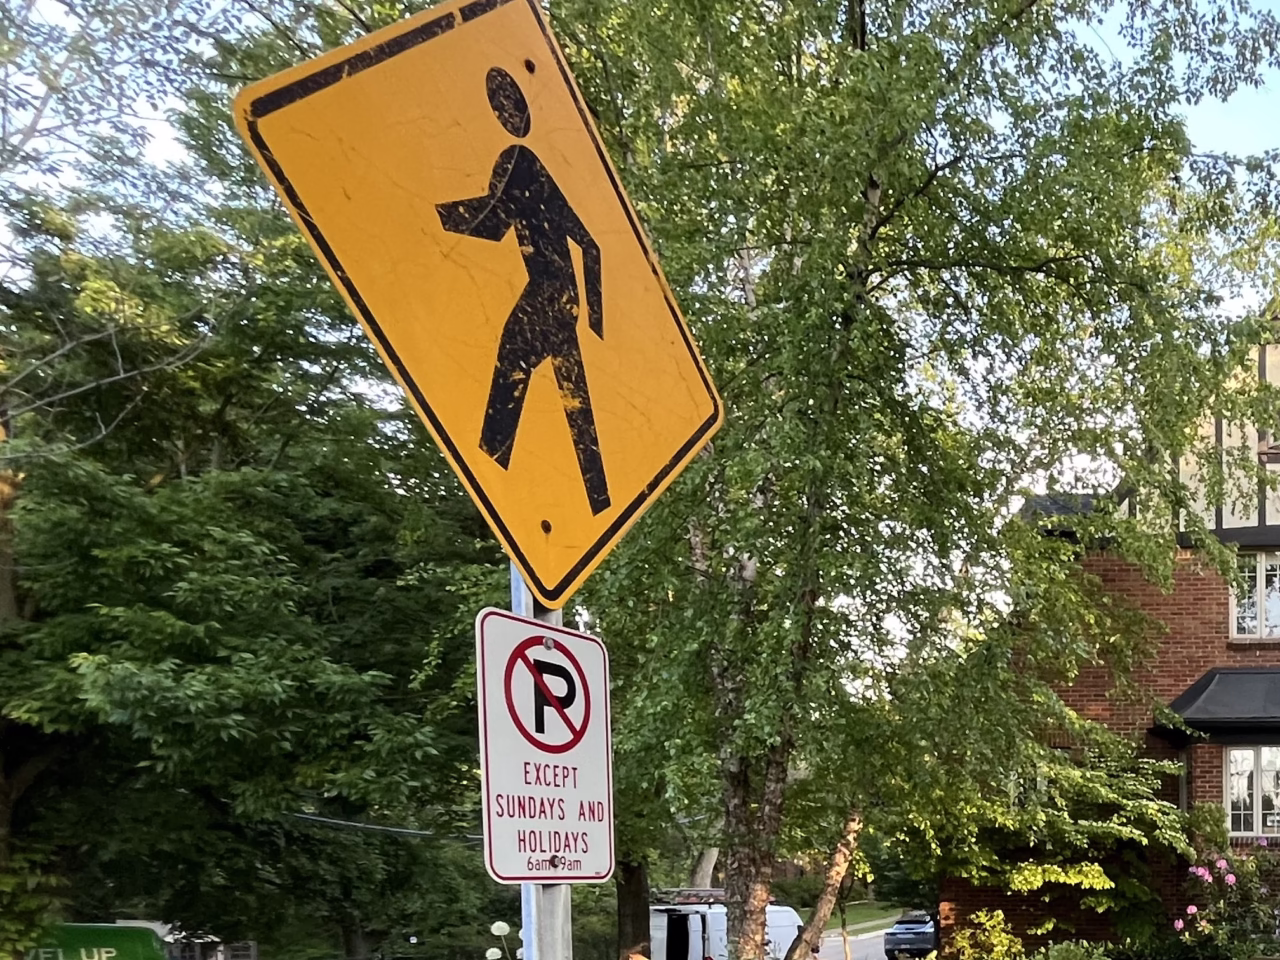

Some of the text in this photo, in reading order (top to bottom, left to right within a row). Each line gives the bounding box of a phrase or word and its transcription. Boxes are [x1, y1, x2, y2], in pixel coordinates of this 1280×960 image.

[524, 762, 578, 789] EXCEPT
[496, 794, 605, 822] SUNDAYS AND
[517, 830, 589, 854] HOLIDAYS
